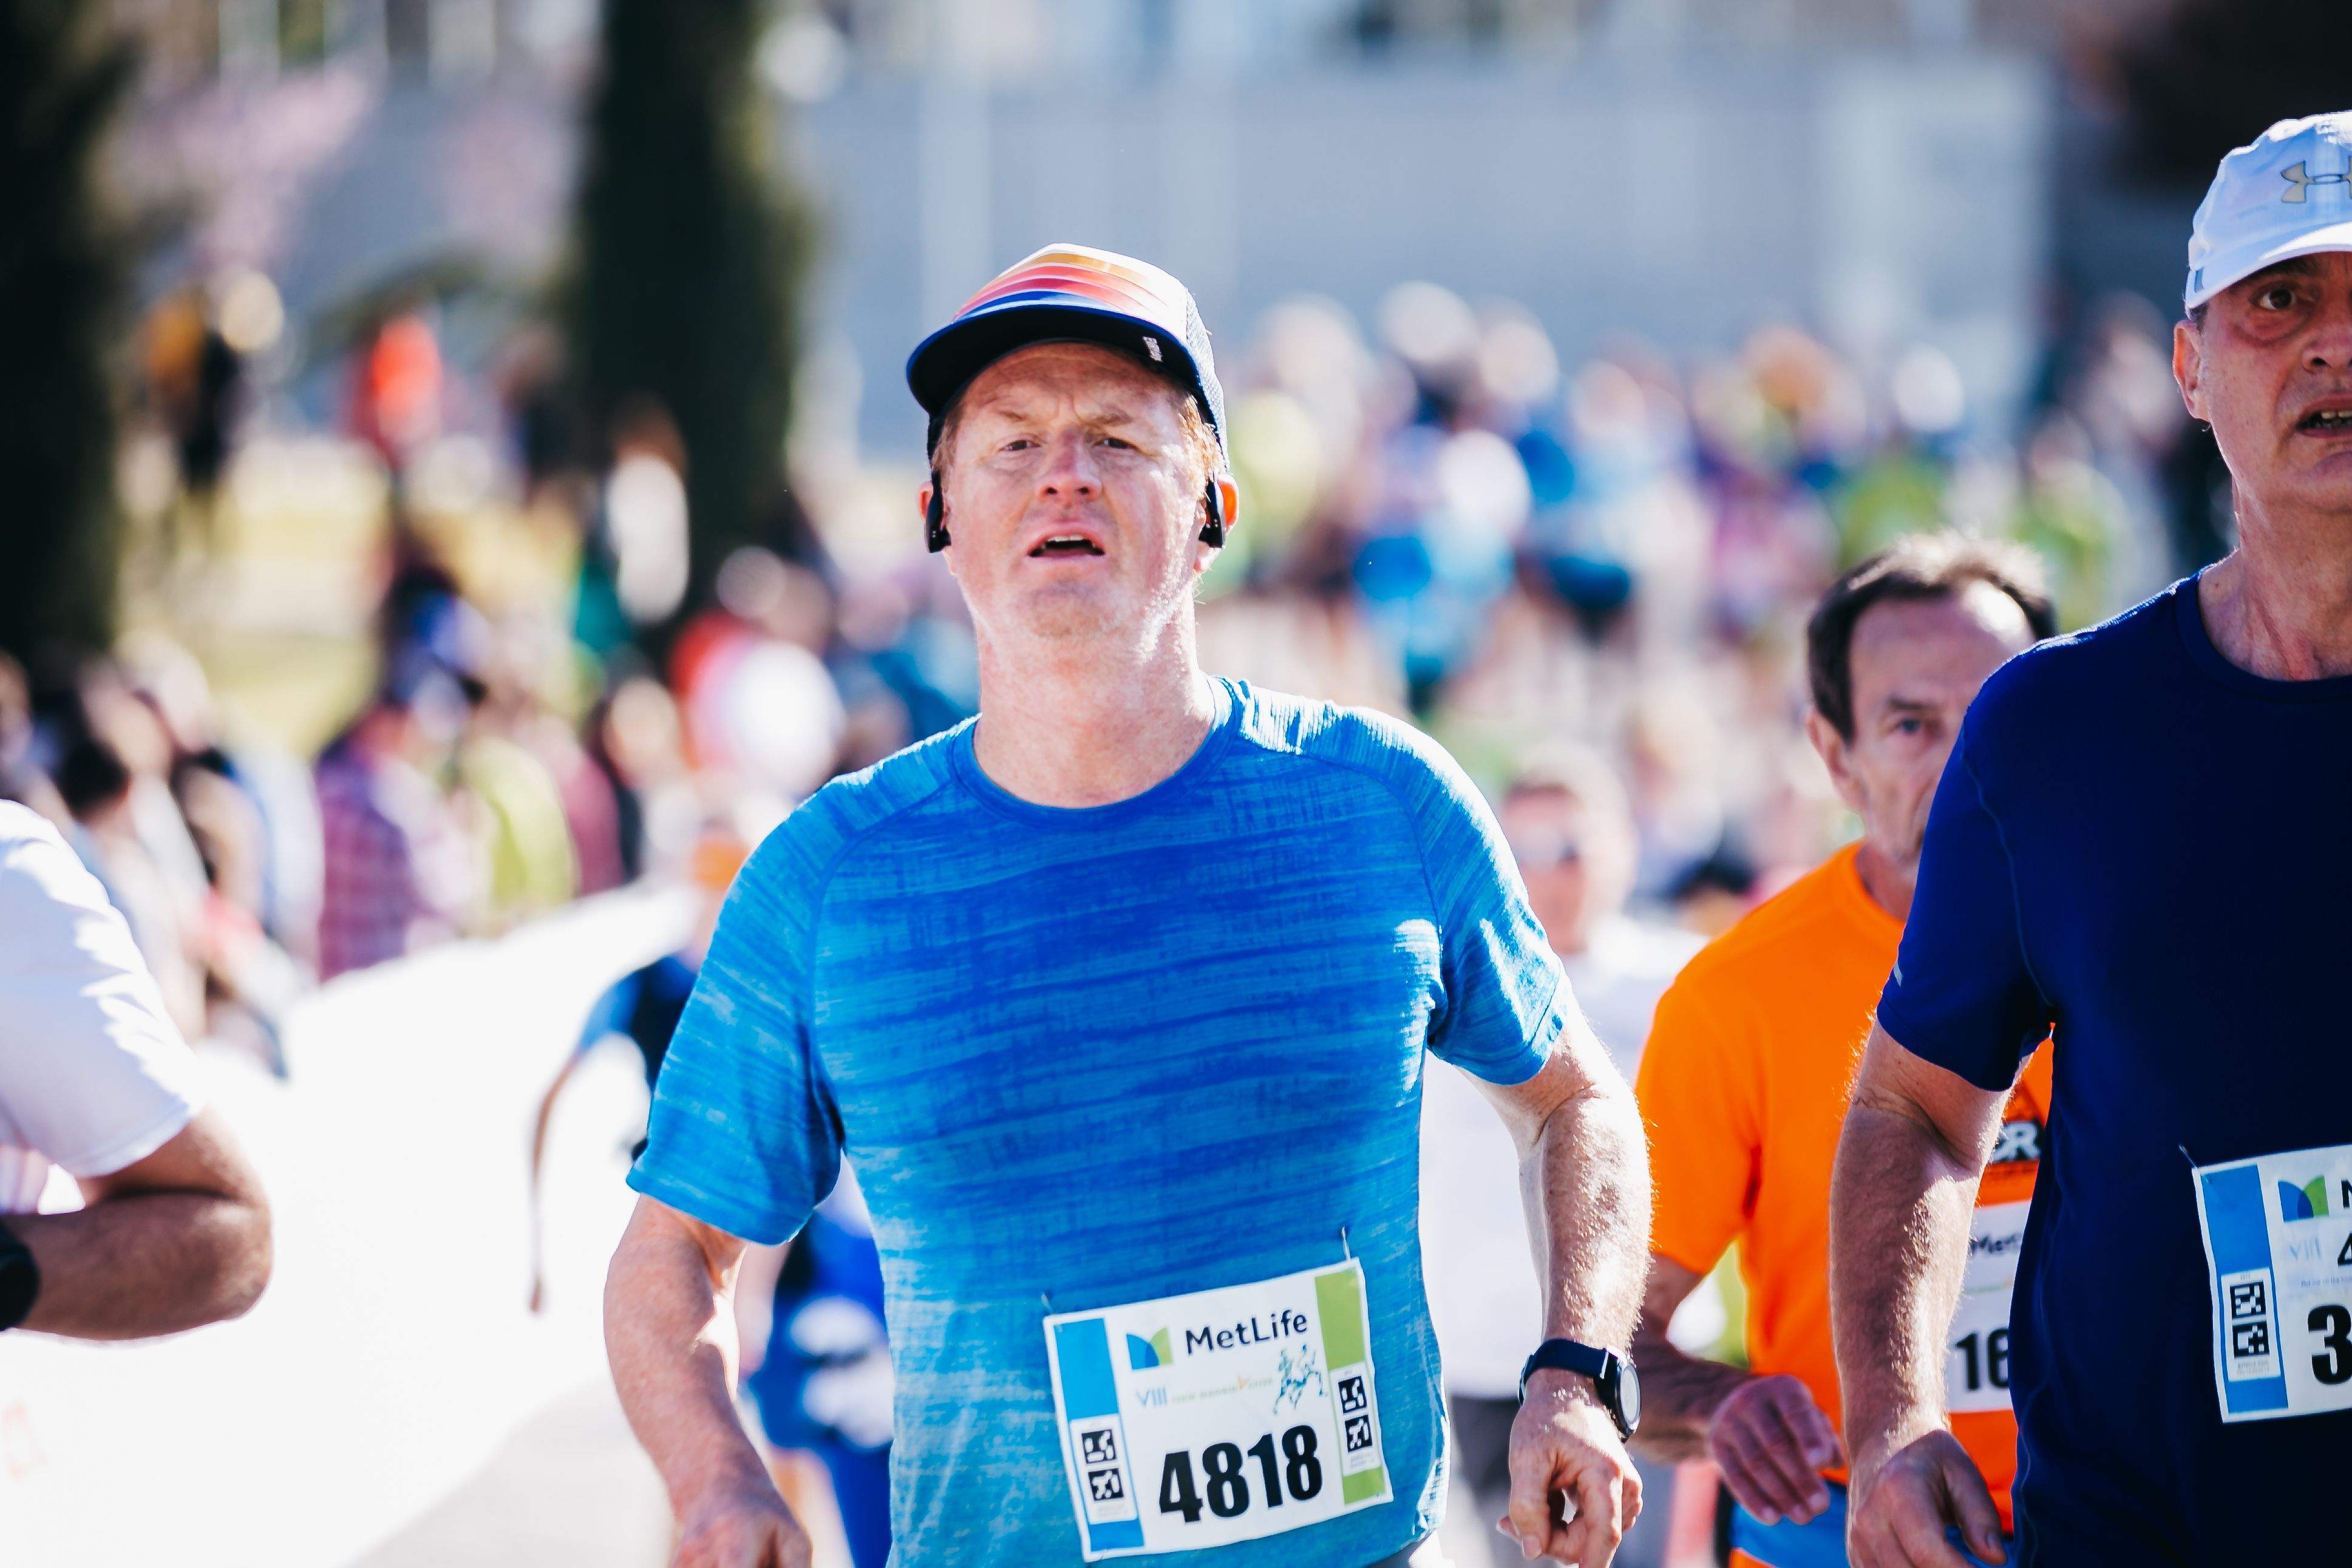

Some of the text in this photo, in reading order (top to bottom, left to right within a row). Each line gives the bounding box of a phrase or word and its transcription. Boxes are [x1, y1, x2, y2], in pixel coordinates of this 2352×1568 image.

[1185, 1309, 1308, 1356] MetLife
[2307, 1303, 2352, 1385] 3
[1136, 1386, 1168, 1407] VIII
[1158, 1424, 1322, 1523] 4818
